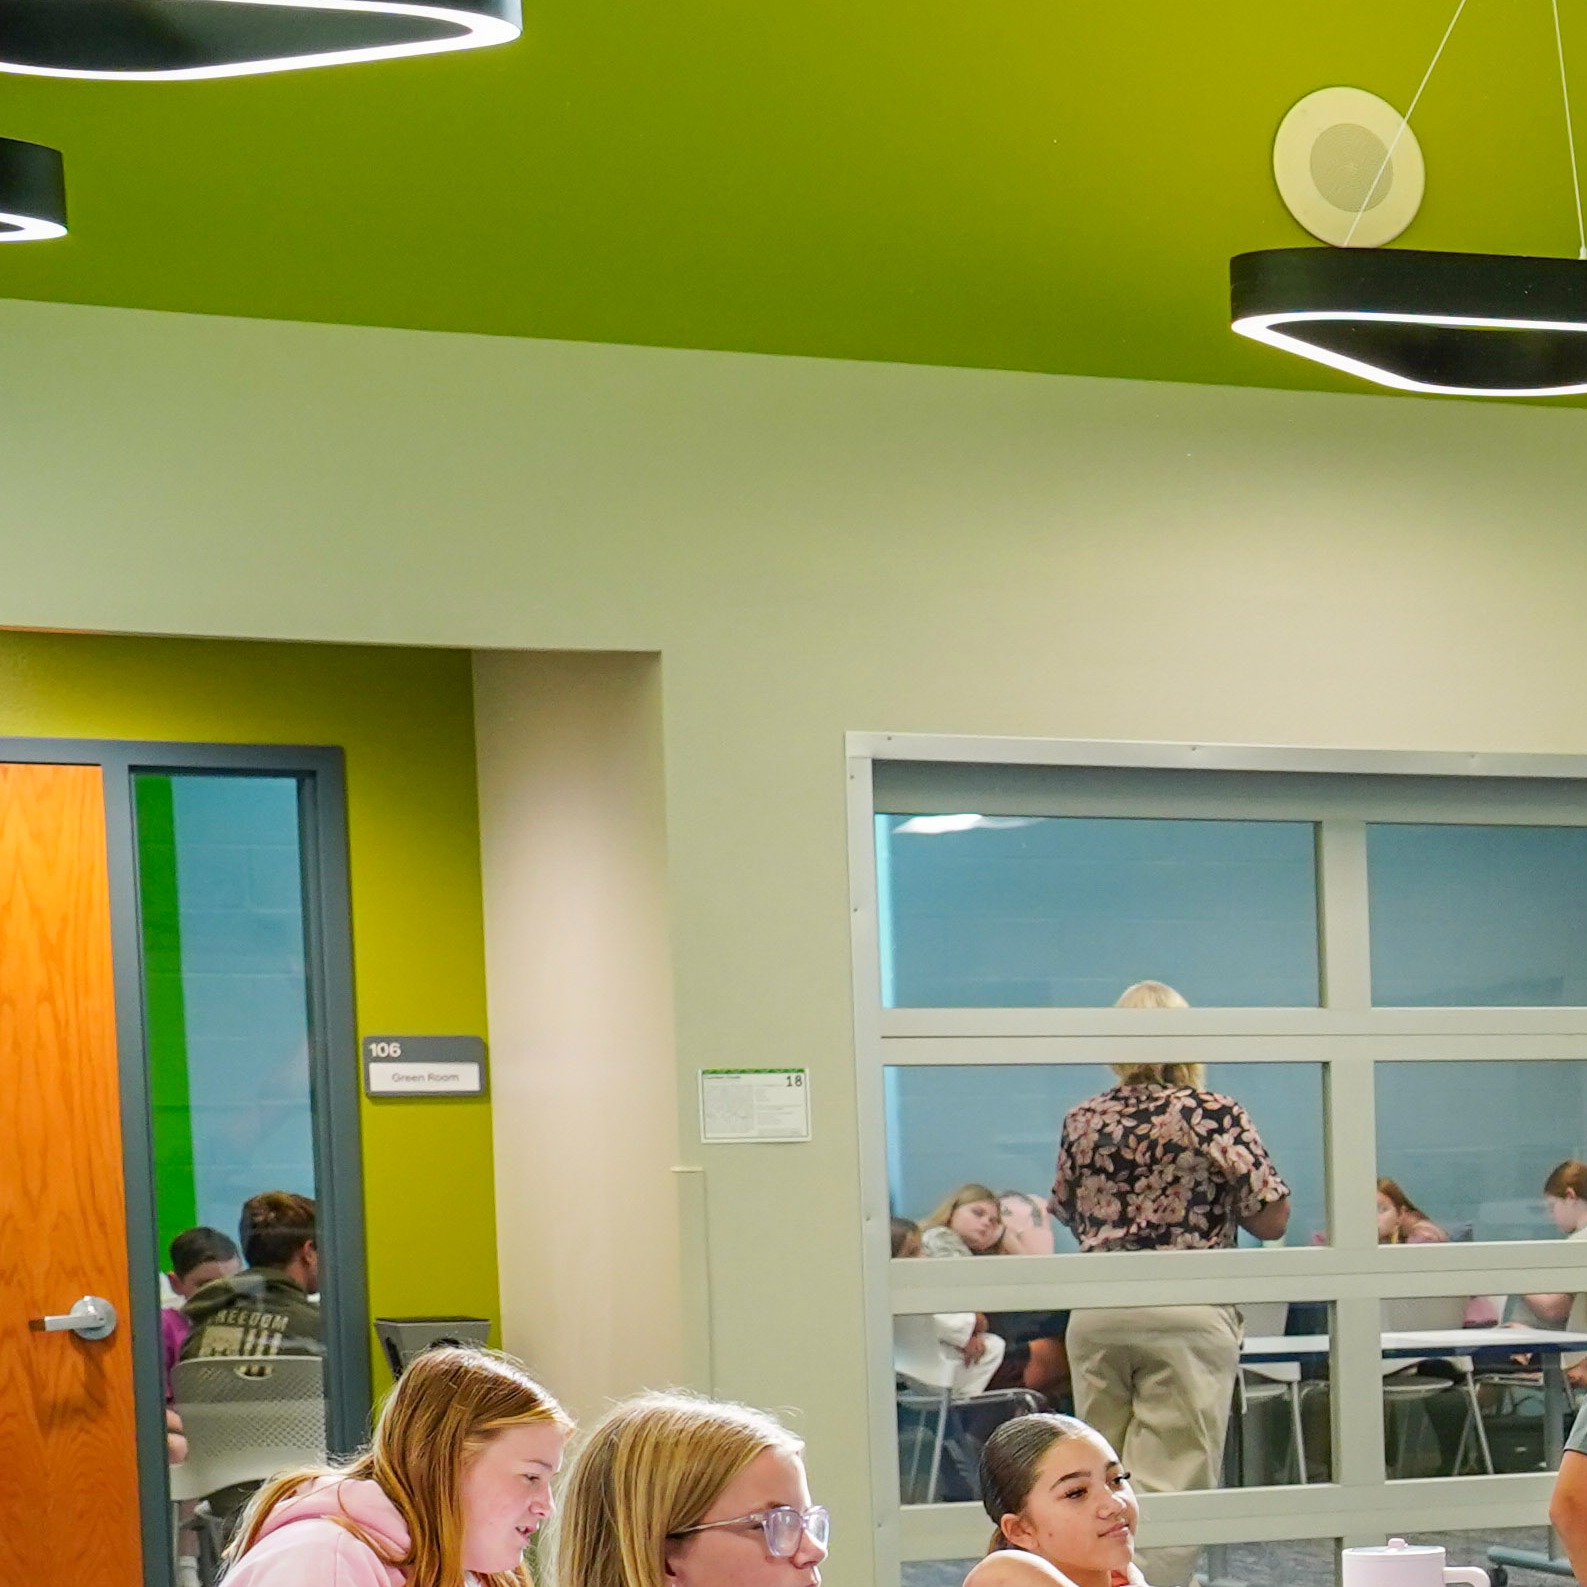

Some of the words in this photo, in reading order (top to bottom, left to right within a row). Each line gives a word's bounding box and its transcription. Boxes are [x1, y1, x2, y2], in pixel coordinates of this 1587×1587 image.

[369, 1042, 402, 1058] 106
[391, 1072, 426, 1083] Green
[427, 1072, 460, 1083] Room
[785, 1074, 803, 1088] 18
[206, 1309, 289, 1333] REEDOM
